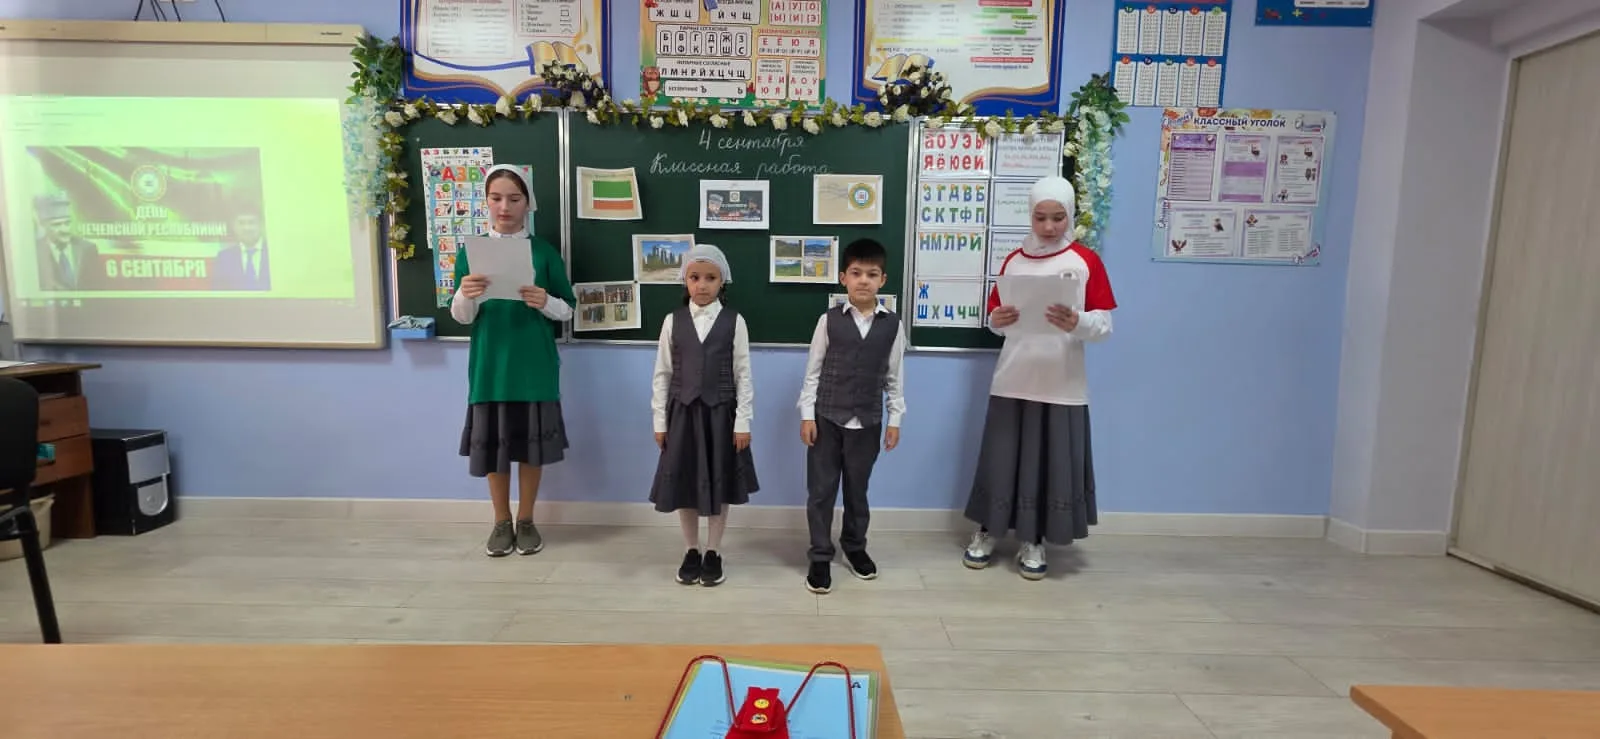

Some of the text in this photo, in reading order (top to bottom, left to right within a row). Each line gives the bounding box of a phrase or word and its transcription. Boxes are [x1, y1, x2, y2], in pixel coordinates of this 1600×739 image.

[656, 9, 664, 17] Ж
[670, 9, 679, 18] Ш
[678, 33, 684, 41] В
[708, 34, 715, 42] Д
[739, 35, 744, 43] З
[762, 37, 769, 46] Е
[791, 38, 800, 47] Ю
[677, 45, 685, 53] Ф
[722, 46, 730, 54] Ш
[691, 69, 697, 77] Р
[699, 68, 706, 76] Й
[718, 69, 725, 78] Ц
[736, 70, 745, 78] Щ
[801, 77, 807, 85] О
[761, 87, 769, 95] Ю
[1193, 116, 1247, 127] КЛАССНЫЙ
[1251, 119, 1286, 128] УГОЛОК
[698, 128, 807, 157] 4 сентября
[650, 151, 831, 181] Классная работа
[921, 206, 985, 223] С К Т Ф П
[920, 235, 930, 251] Н
[957, 235, 967, 251] Р
[105, 259, 207, 278] 6 СЕНТЯБРЯ
[918, 283, 929, 299] Ж
[917, 304, 979, 320] Ш Х Ц Ч Щ
